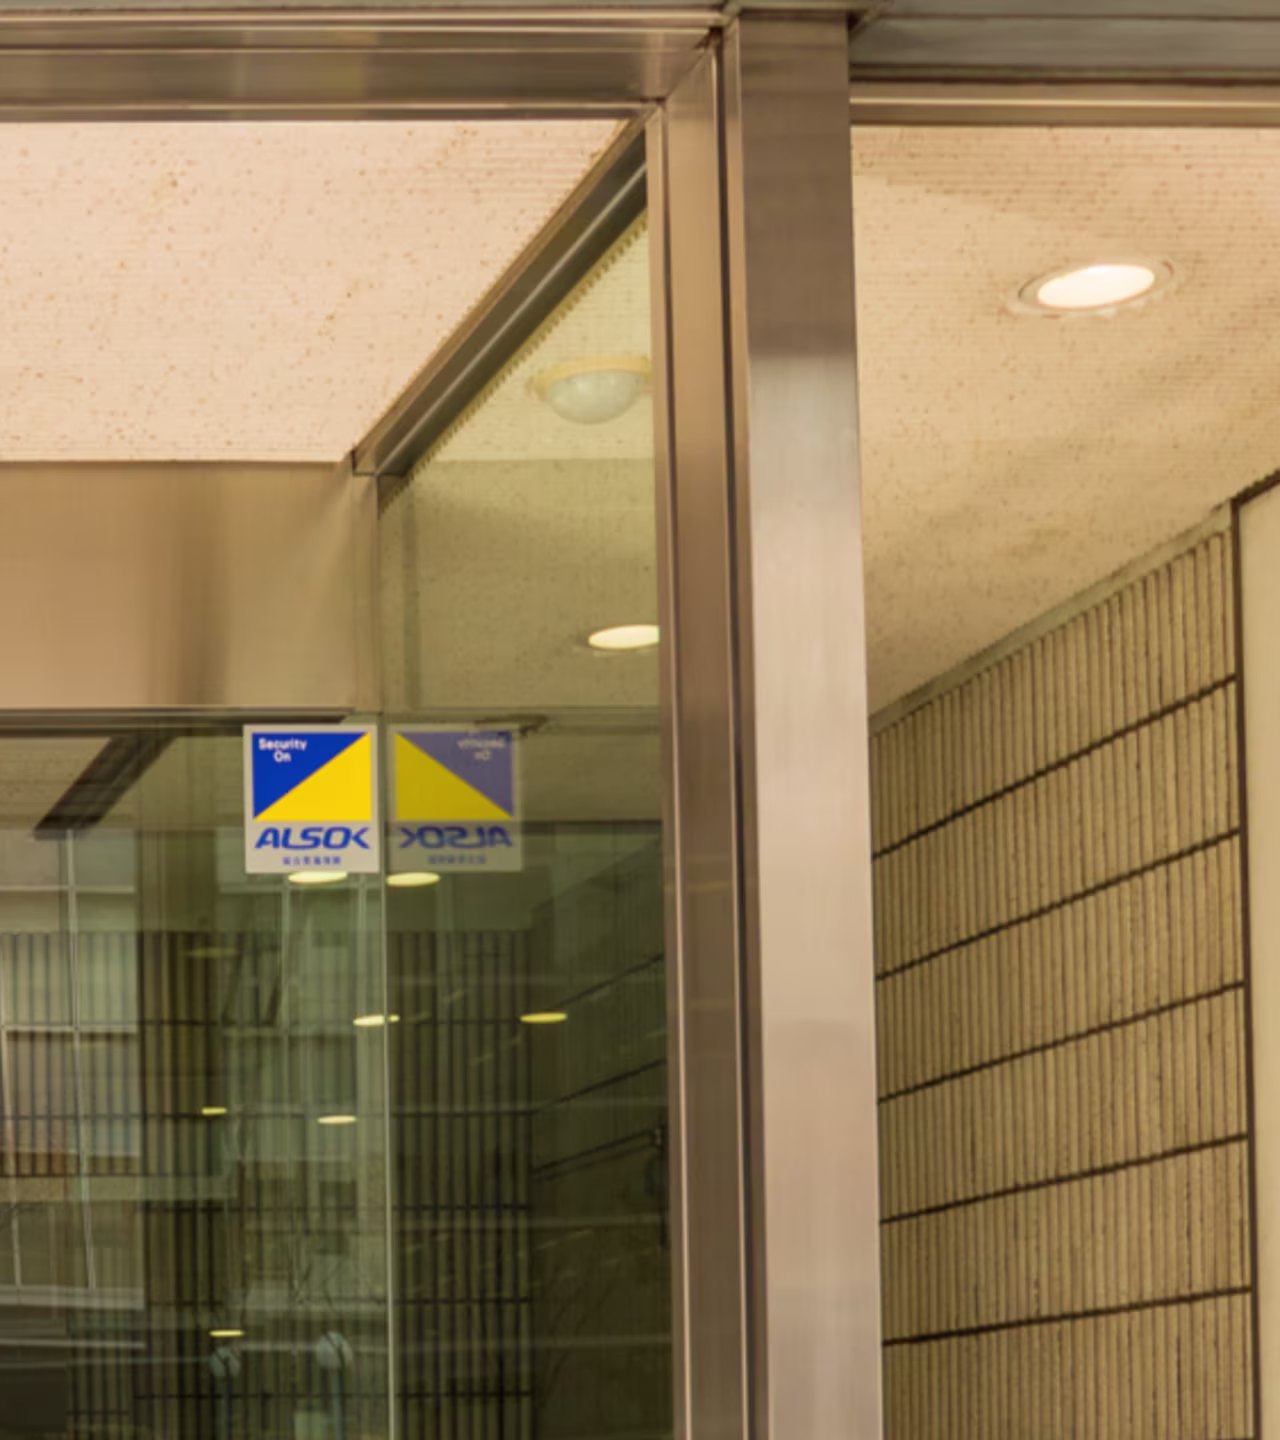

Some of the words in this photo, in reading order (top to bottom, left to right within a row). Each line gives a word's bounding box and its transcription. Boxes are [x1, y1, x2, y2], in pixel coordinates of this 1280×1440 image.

[258, 737, 307, 751] Security
[273, 749, 292, 763] On
[254, 826, 370, 850] ALSOK
